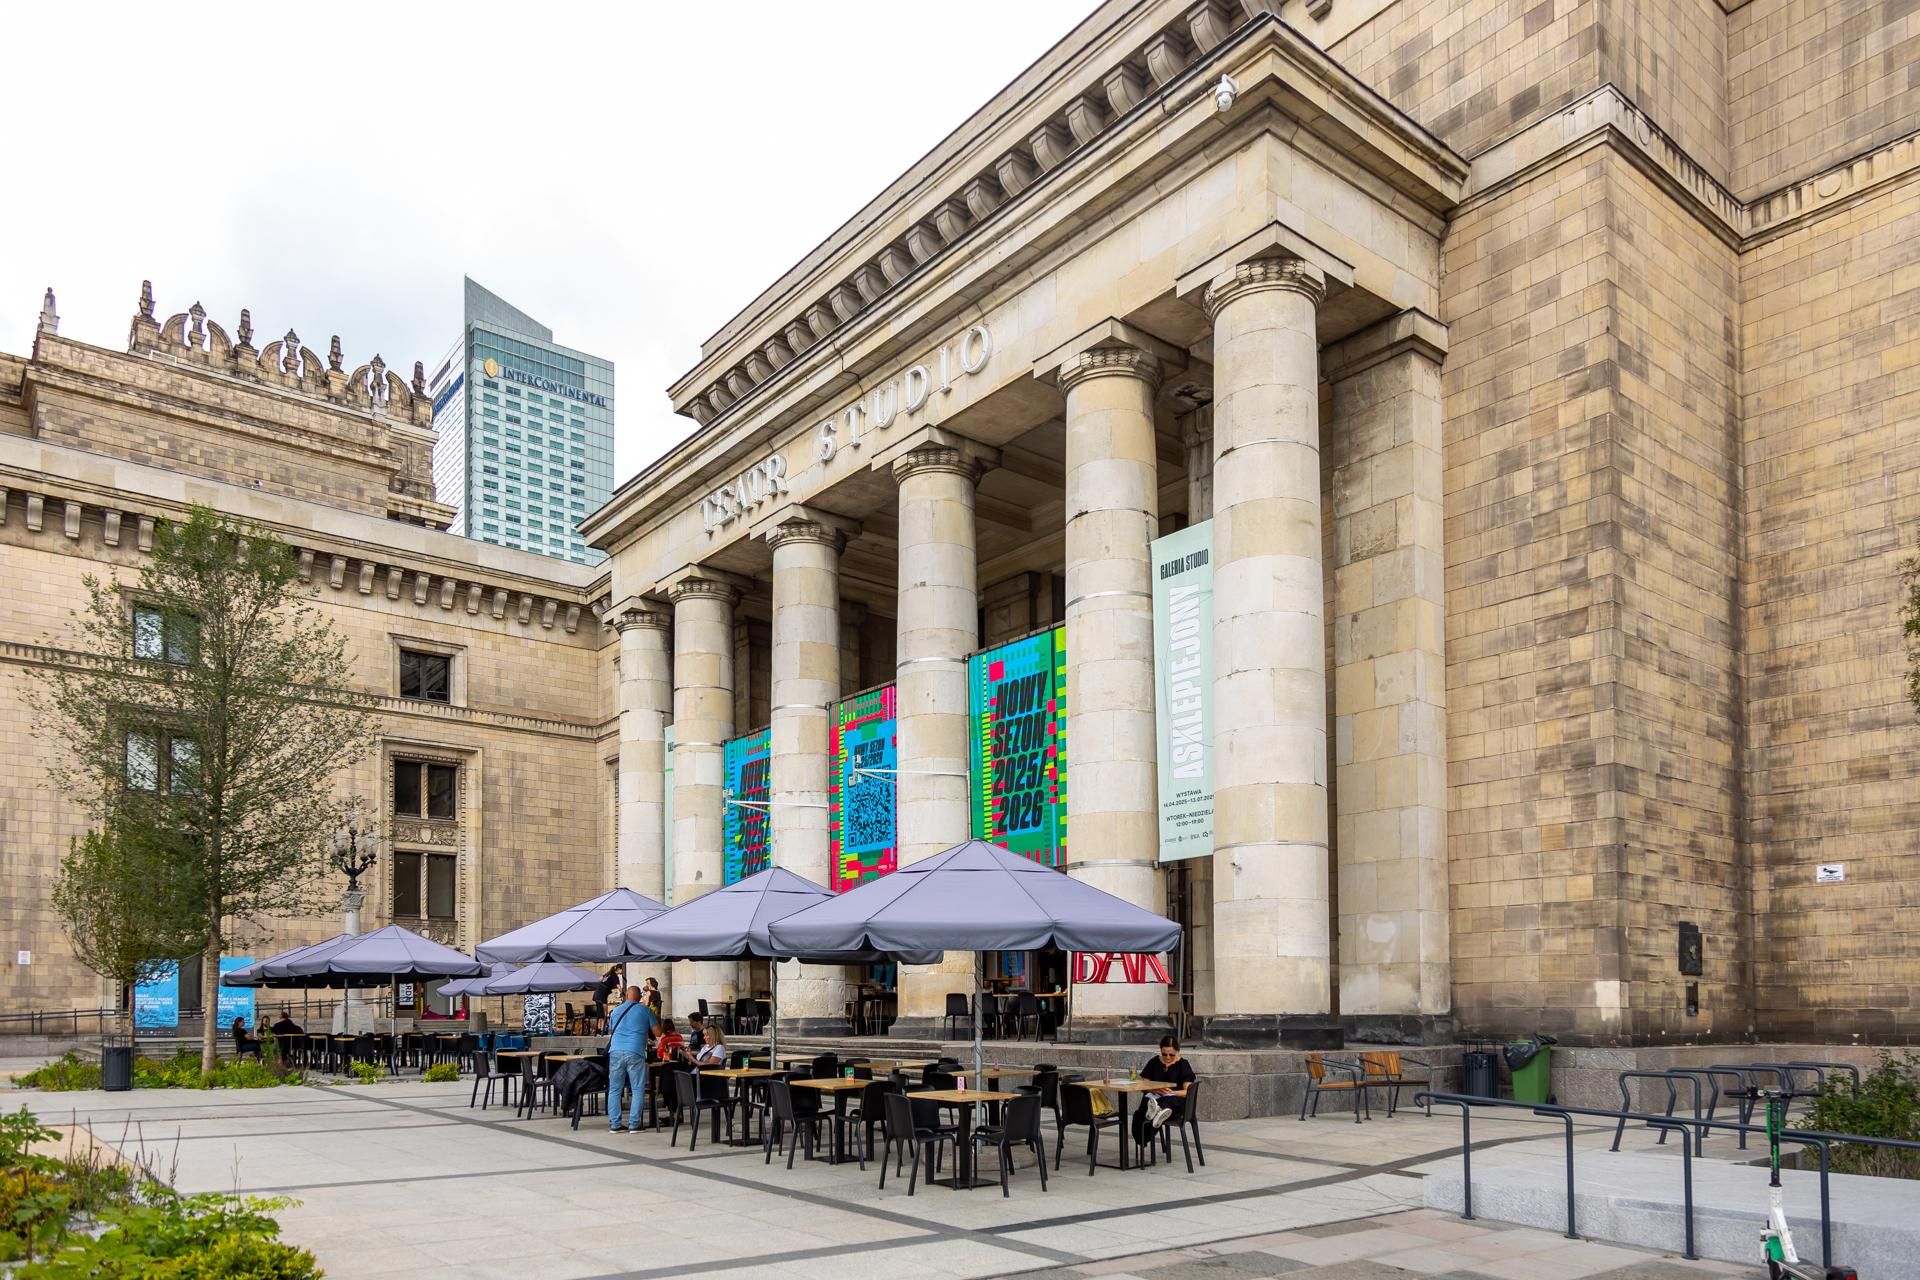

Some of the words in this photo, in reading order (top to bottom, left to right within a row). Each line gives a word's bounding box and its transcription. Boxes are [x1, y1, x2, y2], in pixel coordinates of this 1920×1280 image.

[700, 454, 789, 535] TEATR
[819, 325, 993, 463] STUDIO
[1160, 557, 1185, 580] GALERIA
[1185, 548, 1209, 571] STUDIO
[995, 669, 1049, 721] NOWY
[1169, 583, 1203, 779] ASKLEPIEJONY
[992, 710, 1047, 759] SEZON
[992, 749, 1049, 797] 2025/
[1175, 789, 1202, 798] WYSTAWA
[997, 789, 1045, 834] 2026
